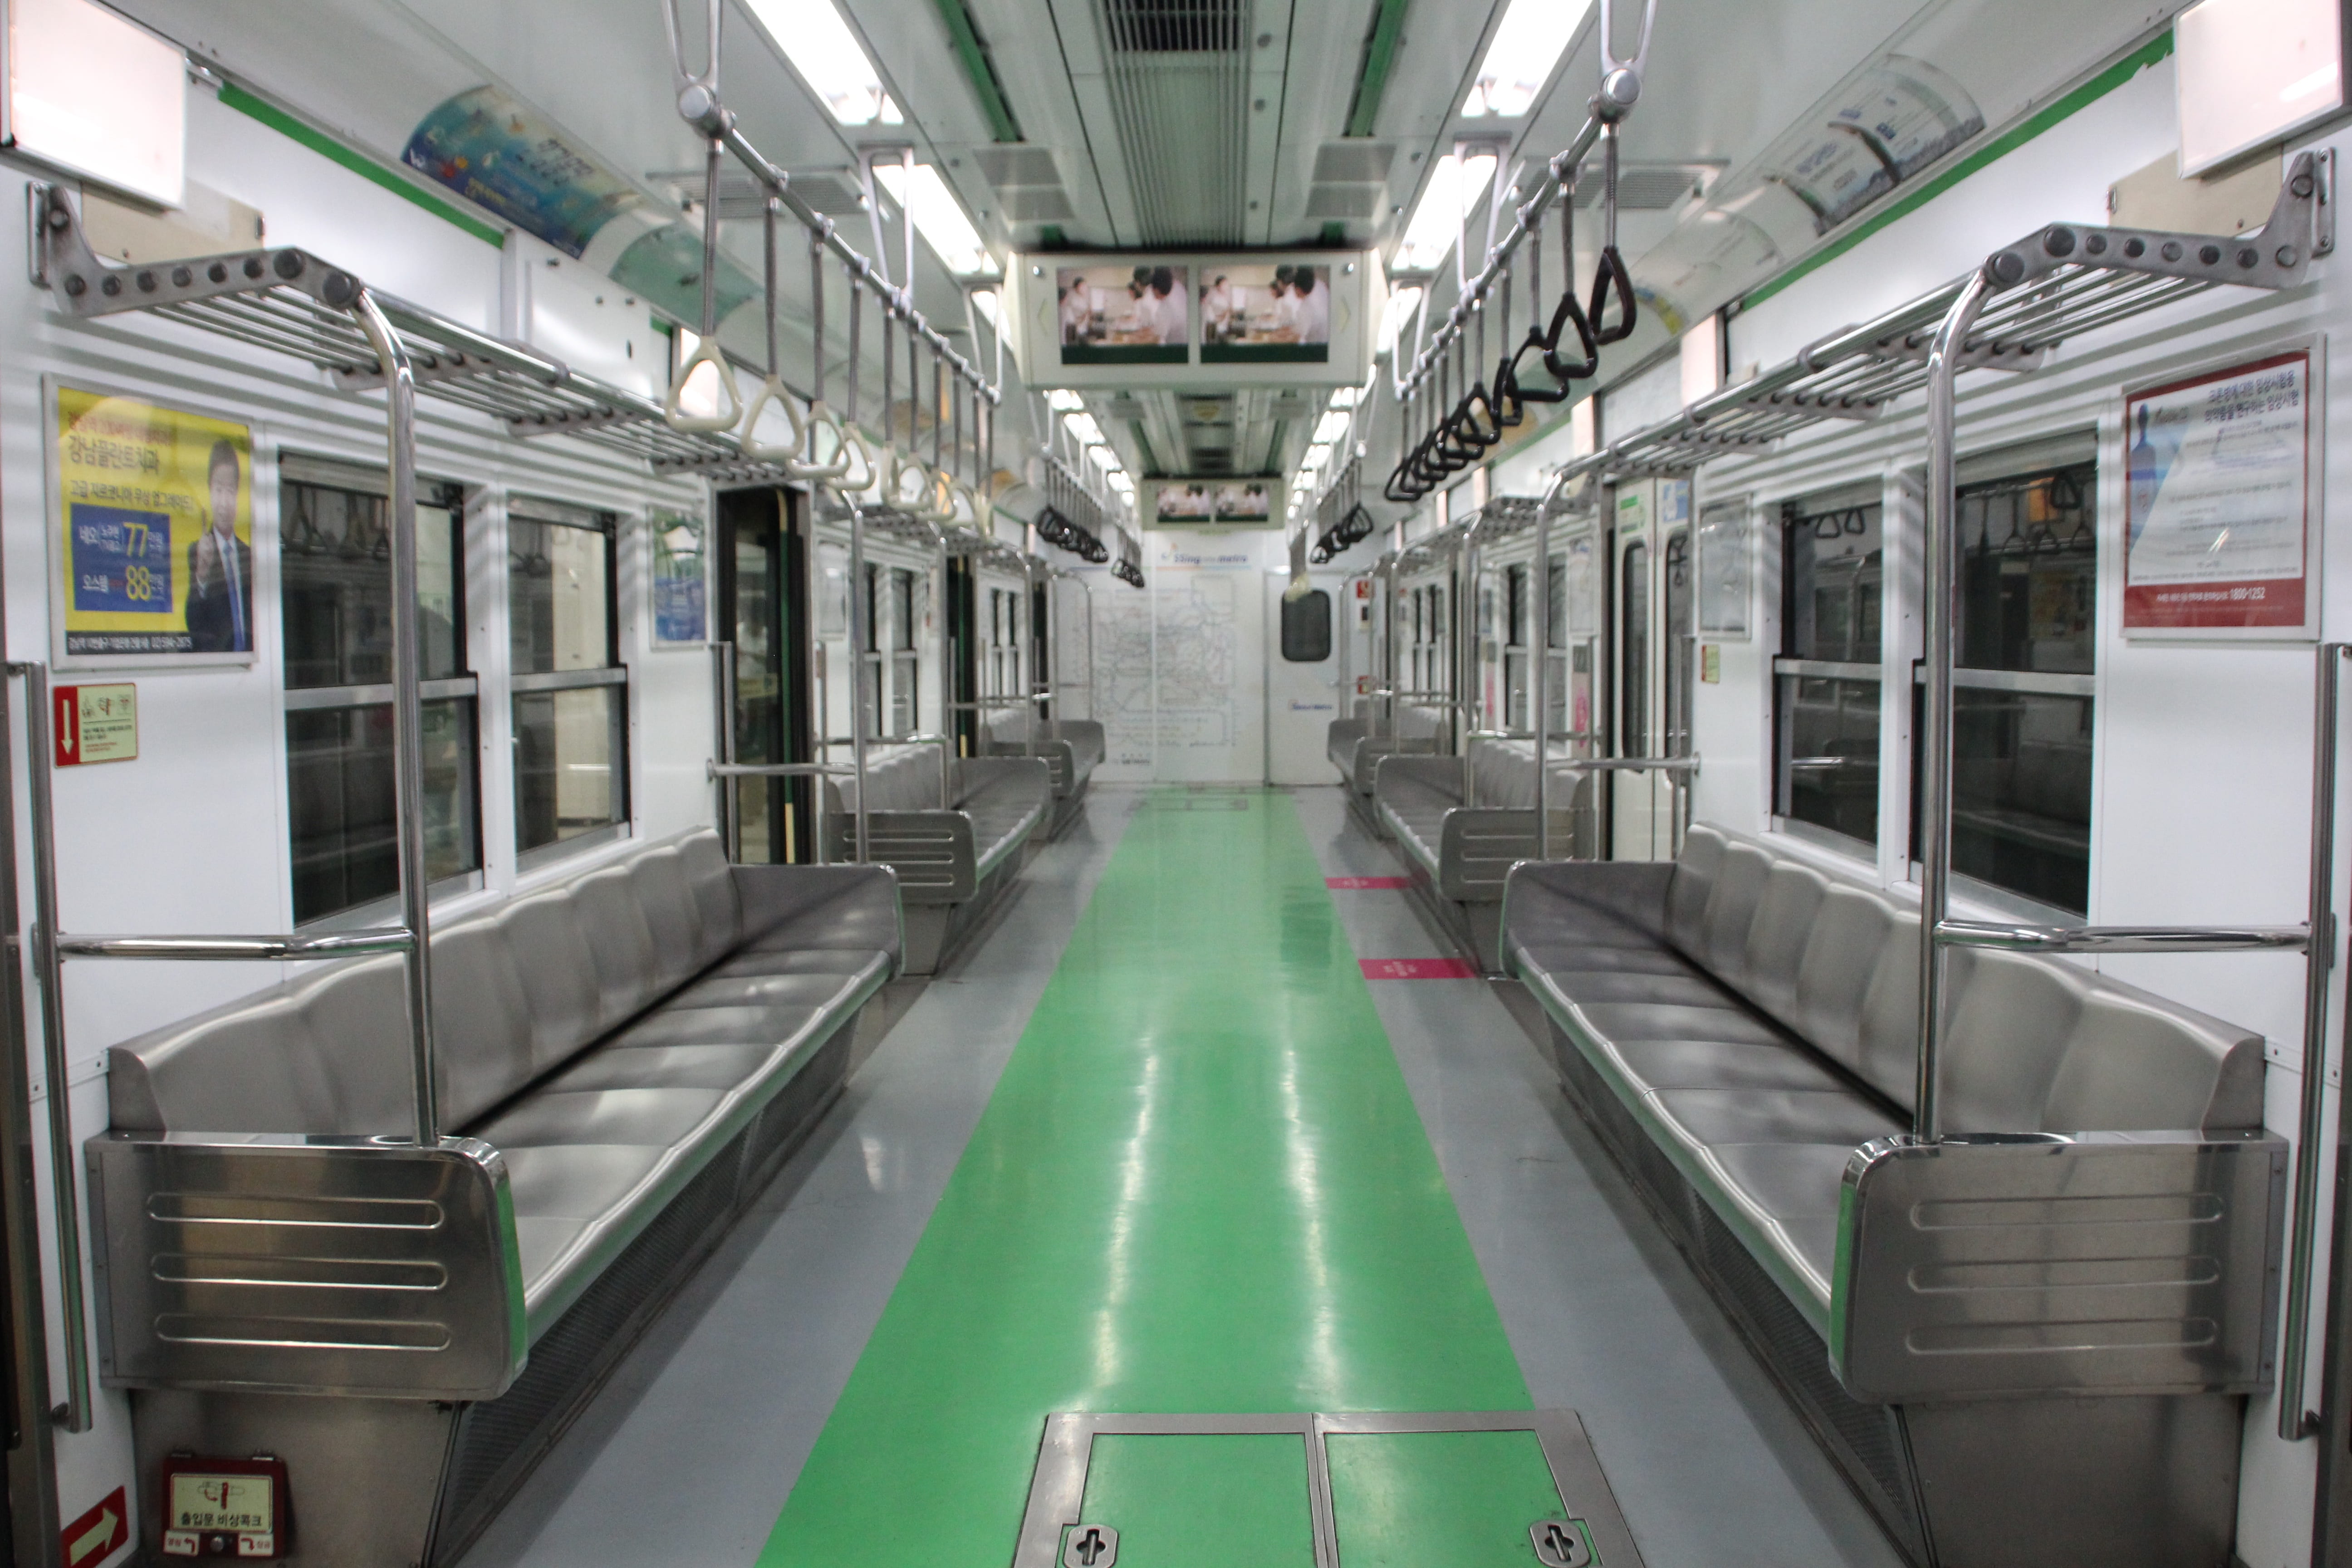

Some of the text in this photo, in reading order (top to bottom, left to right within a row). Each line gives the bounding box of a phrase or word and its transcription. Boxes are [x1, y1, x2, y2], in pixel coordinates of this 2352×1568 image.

[2256, 370, 2295, 395] 임상시험용
[2267, 389, 2299, 412] 임상시험
[181, 1512, 262, 1527] 출입문 비상콕크
